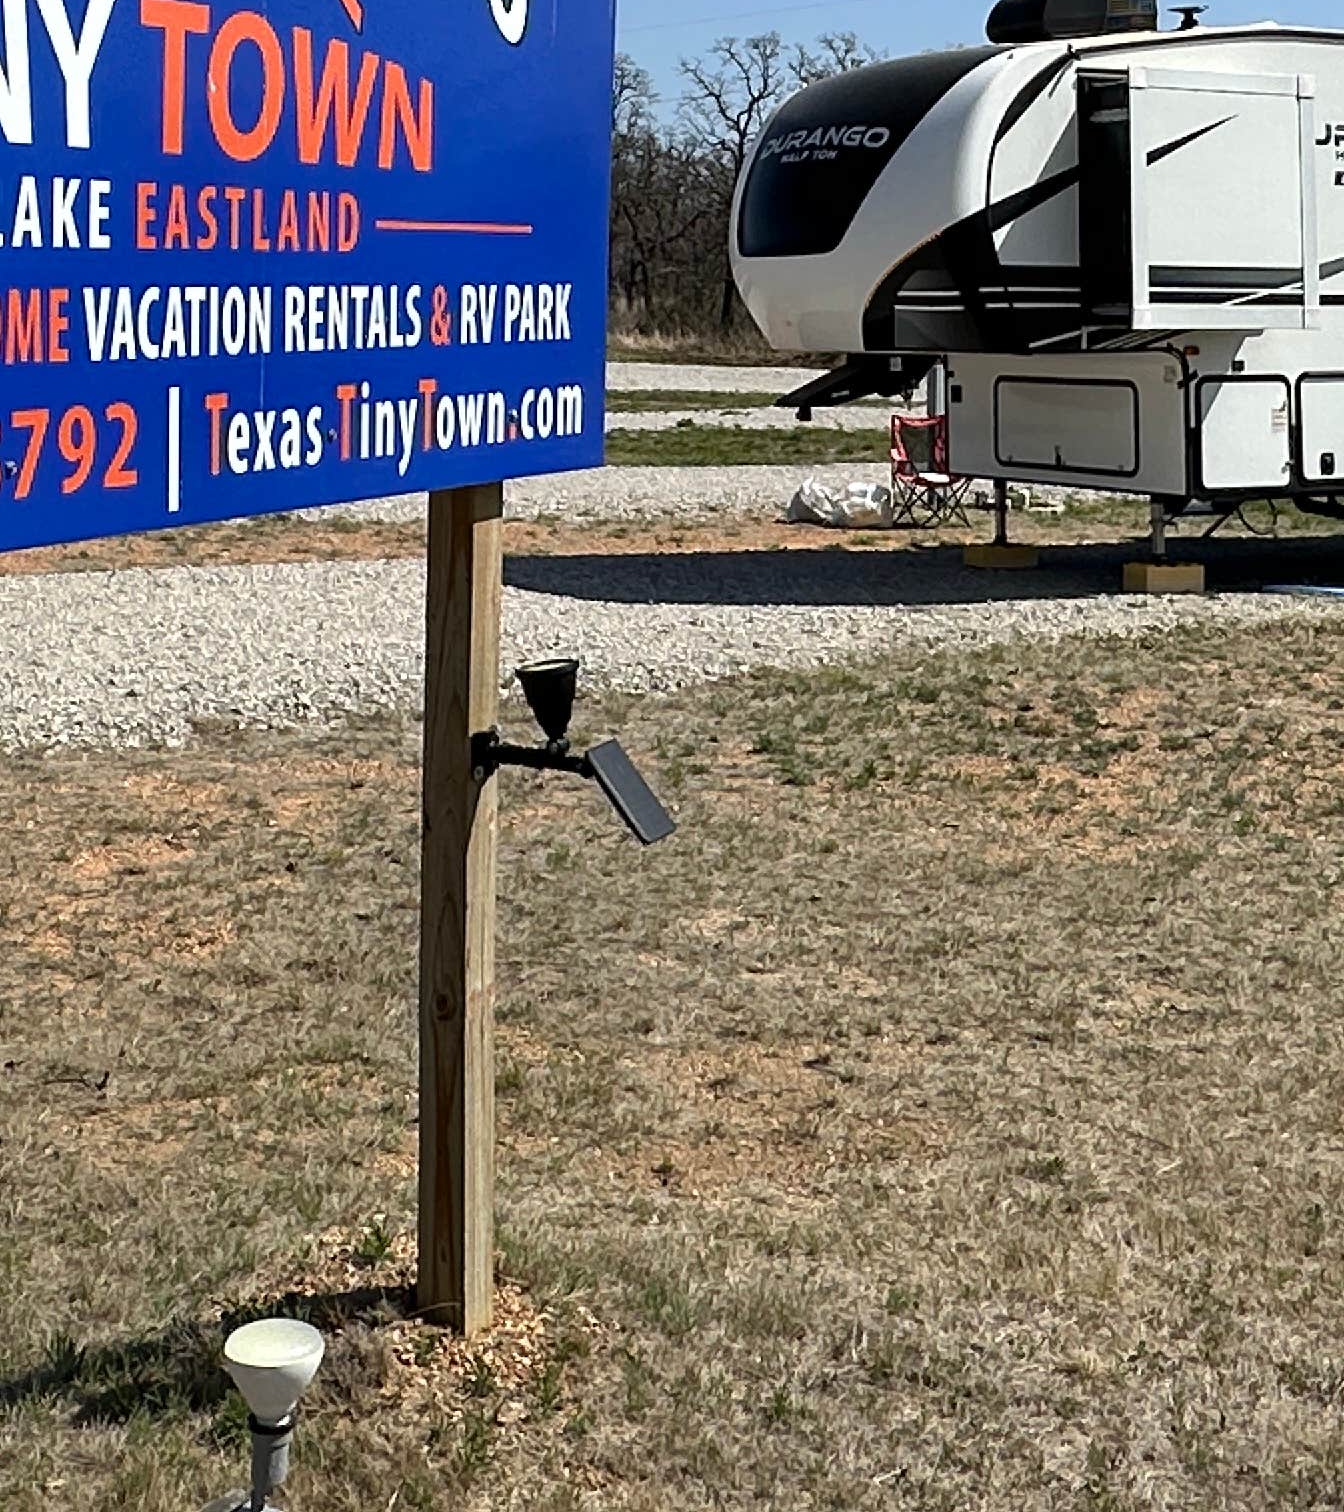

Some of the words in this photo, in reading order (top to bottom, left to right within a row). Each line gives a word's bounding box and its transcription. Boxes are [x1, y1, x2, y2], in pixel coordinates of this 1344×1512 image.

[760, 126, 890, 160] DURANGO
[136, 182, 361, 253] EASTLAND
[82, 285, 272, 363] VACATION
[284, 284, 422, 353] RENTALS
[429, 284, 452, 348] &
[460, 284, 498, 347] RV
[504, 283, 572, 343] PARK
